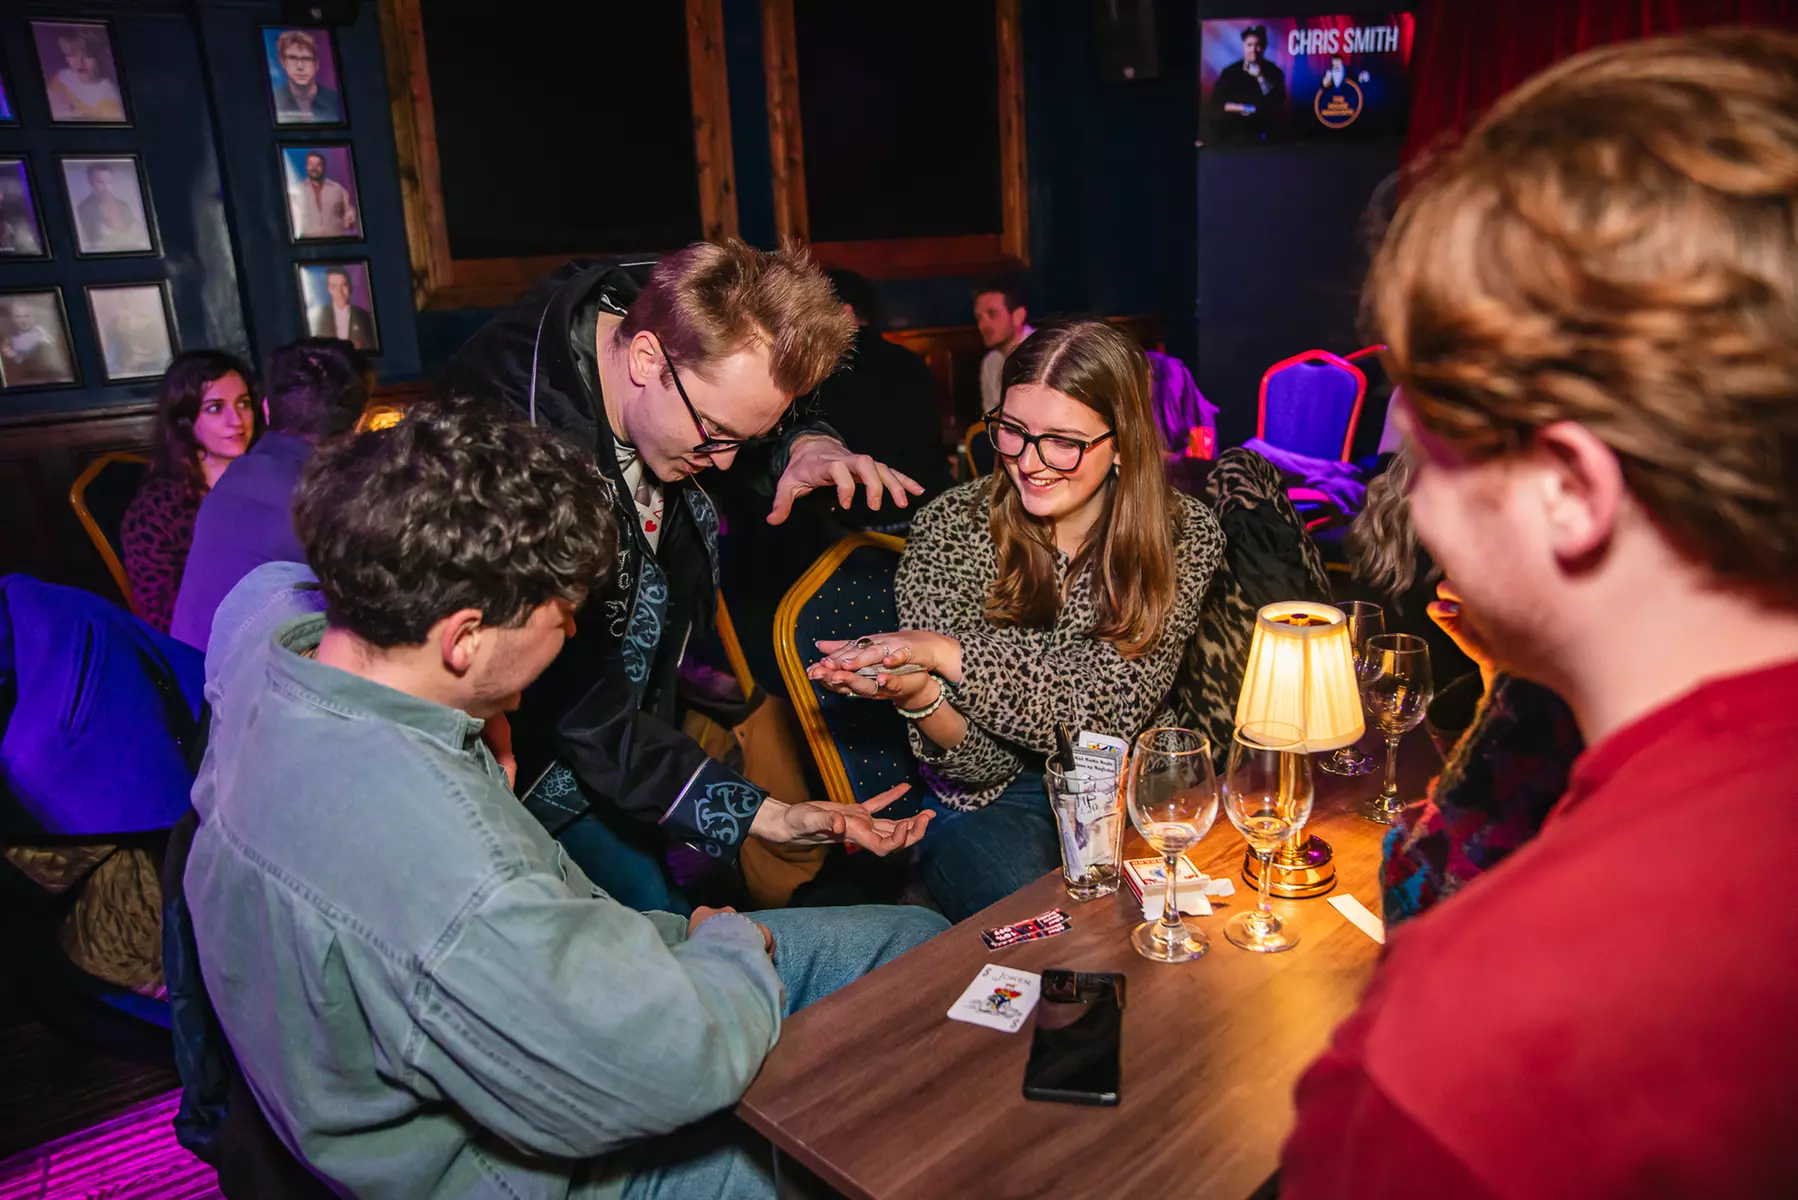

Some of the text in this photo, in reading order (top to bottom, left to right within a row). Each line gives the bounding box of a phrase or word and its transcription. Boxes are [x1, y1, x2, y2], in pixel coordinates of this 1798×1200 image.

[1288, 25, 1399, 56] CHRIS SMITH
[993, 927, 1012, 936] OFF
[995, 931, 1017, 941] 10%
